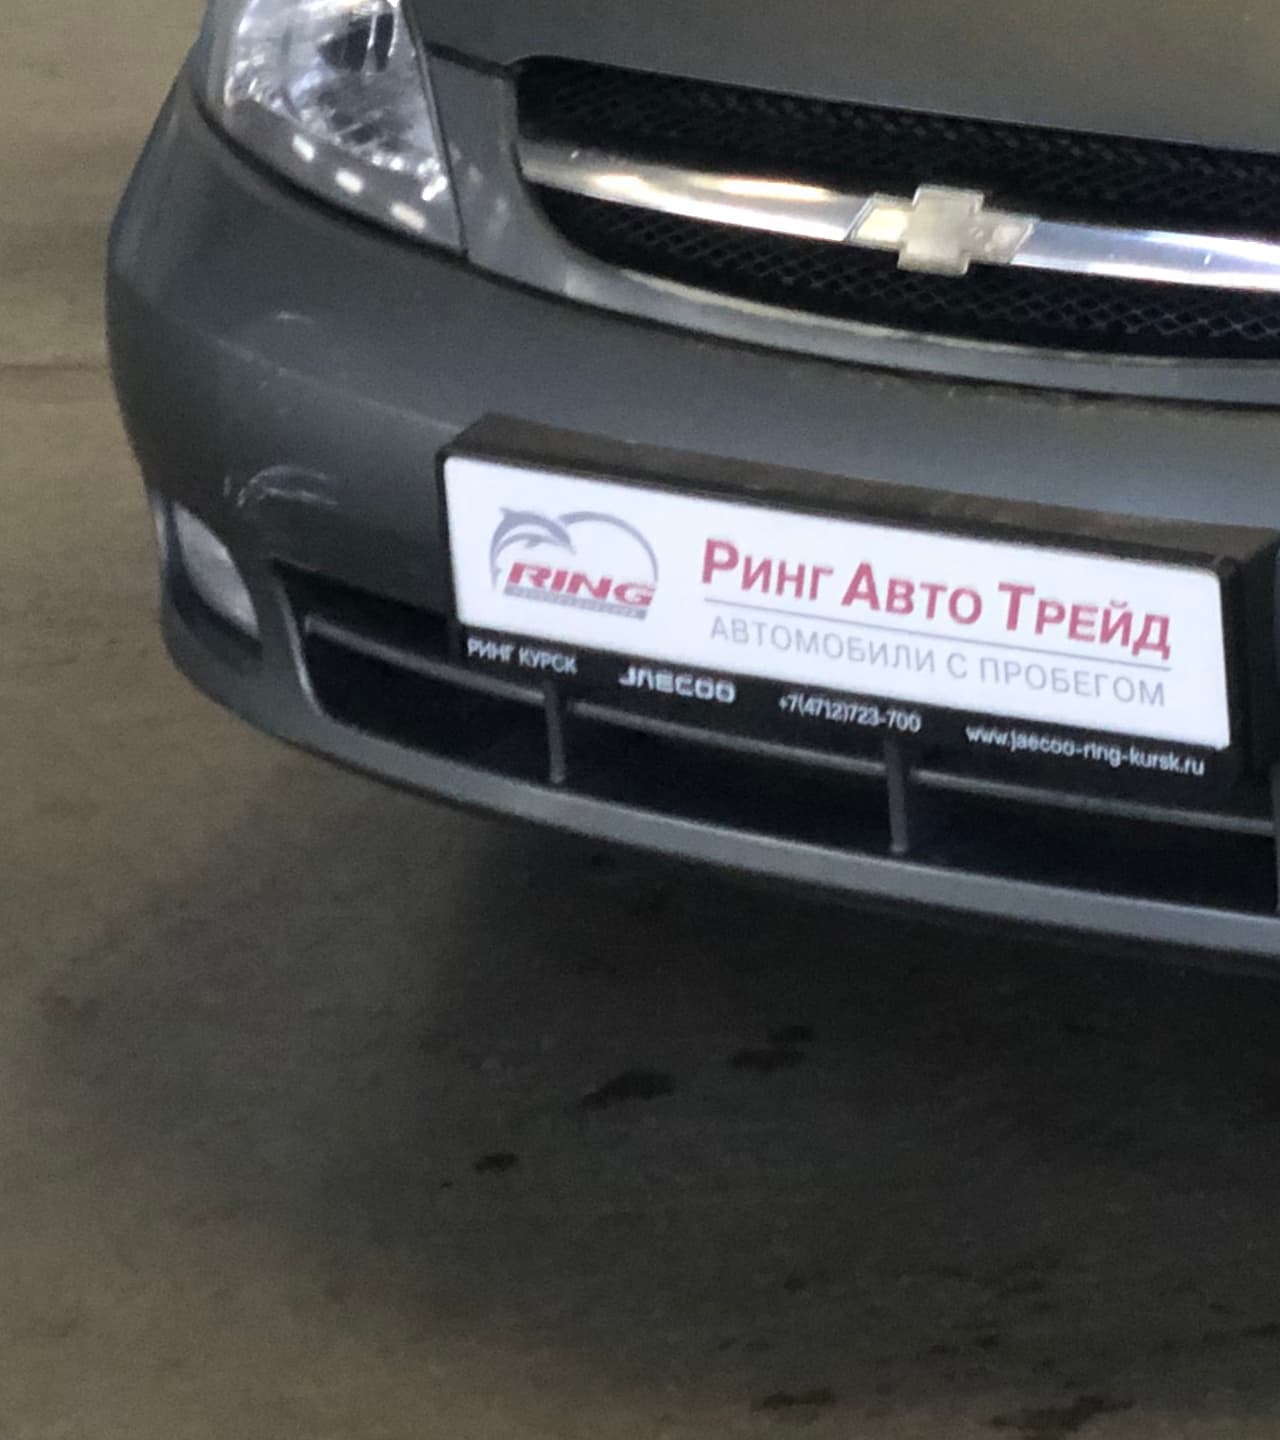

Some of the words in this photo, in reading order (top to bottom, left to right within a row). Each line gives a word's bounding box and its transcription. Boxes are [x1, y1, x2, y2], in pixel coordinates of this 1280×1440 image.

[507, 562, 658, 607] RING
[467, 637, 516, 661] РИНГ
[519, 647, 578, 675] КУРСК
[709, 615, 935, 673] АВТОМОБИЛИ
[946, 652, 968, 680] С
[980, 657, 1166, 708] ПРОБЕГОМ
[778, 693, 922, 734] +7(4712)723-700
[965, 725, 1205, 777] www.jaecoo-ring-kursk.ru
